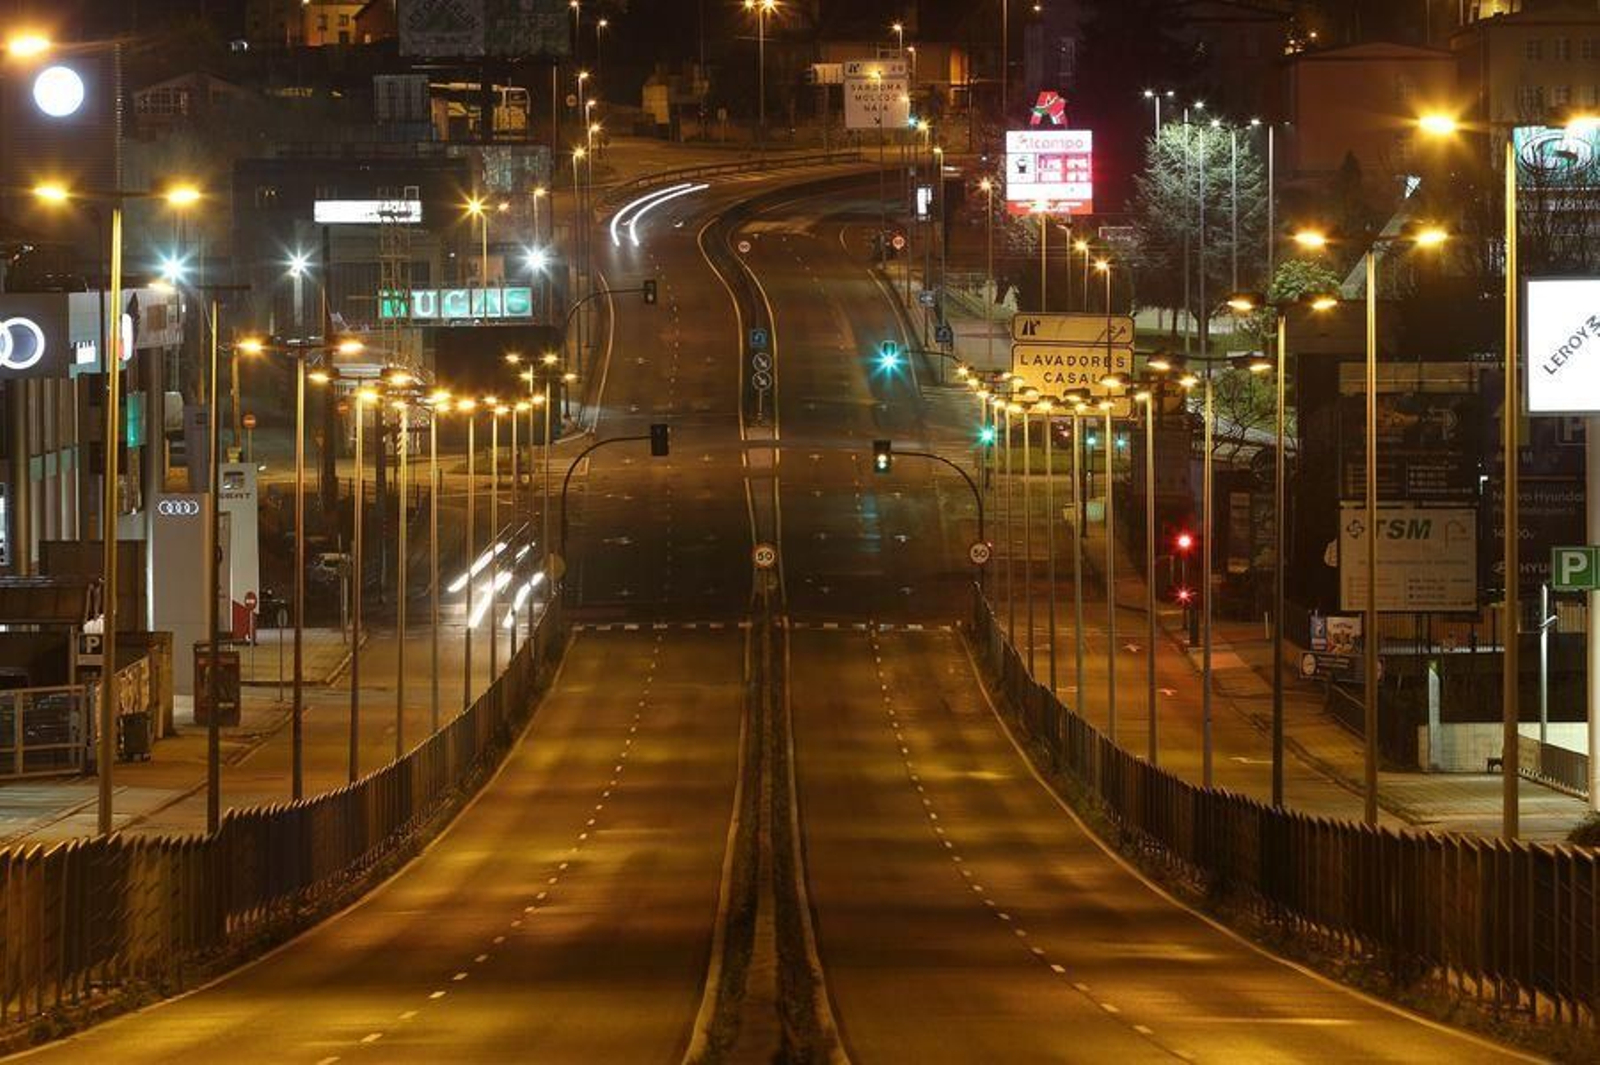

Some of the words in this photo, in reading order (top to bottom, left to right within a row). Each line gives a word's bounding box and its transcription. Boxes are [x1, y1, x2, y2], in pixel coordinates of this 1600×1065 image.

[1020, 354, 1125, 368] LAVADORES
[1543, 326, 1589, 375] LEROY
[1376, 519, 1431, 540] TSM
[1562, 551, 1588, 585] P
[86, 636, 100, 654] P
